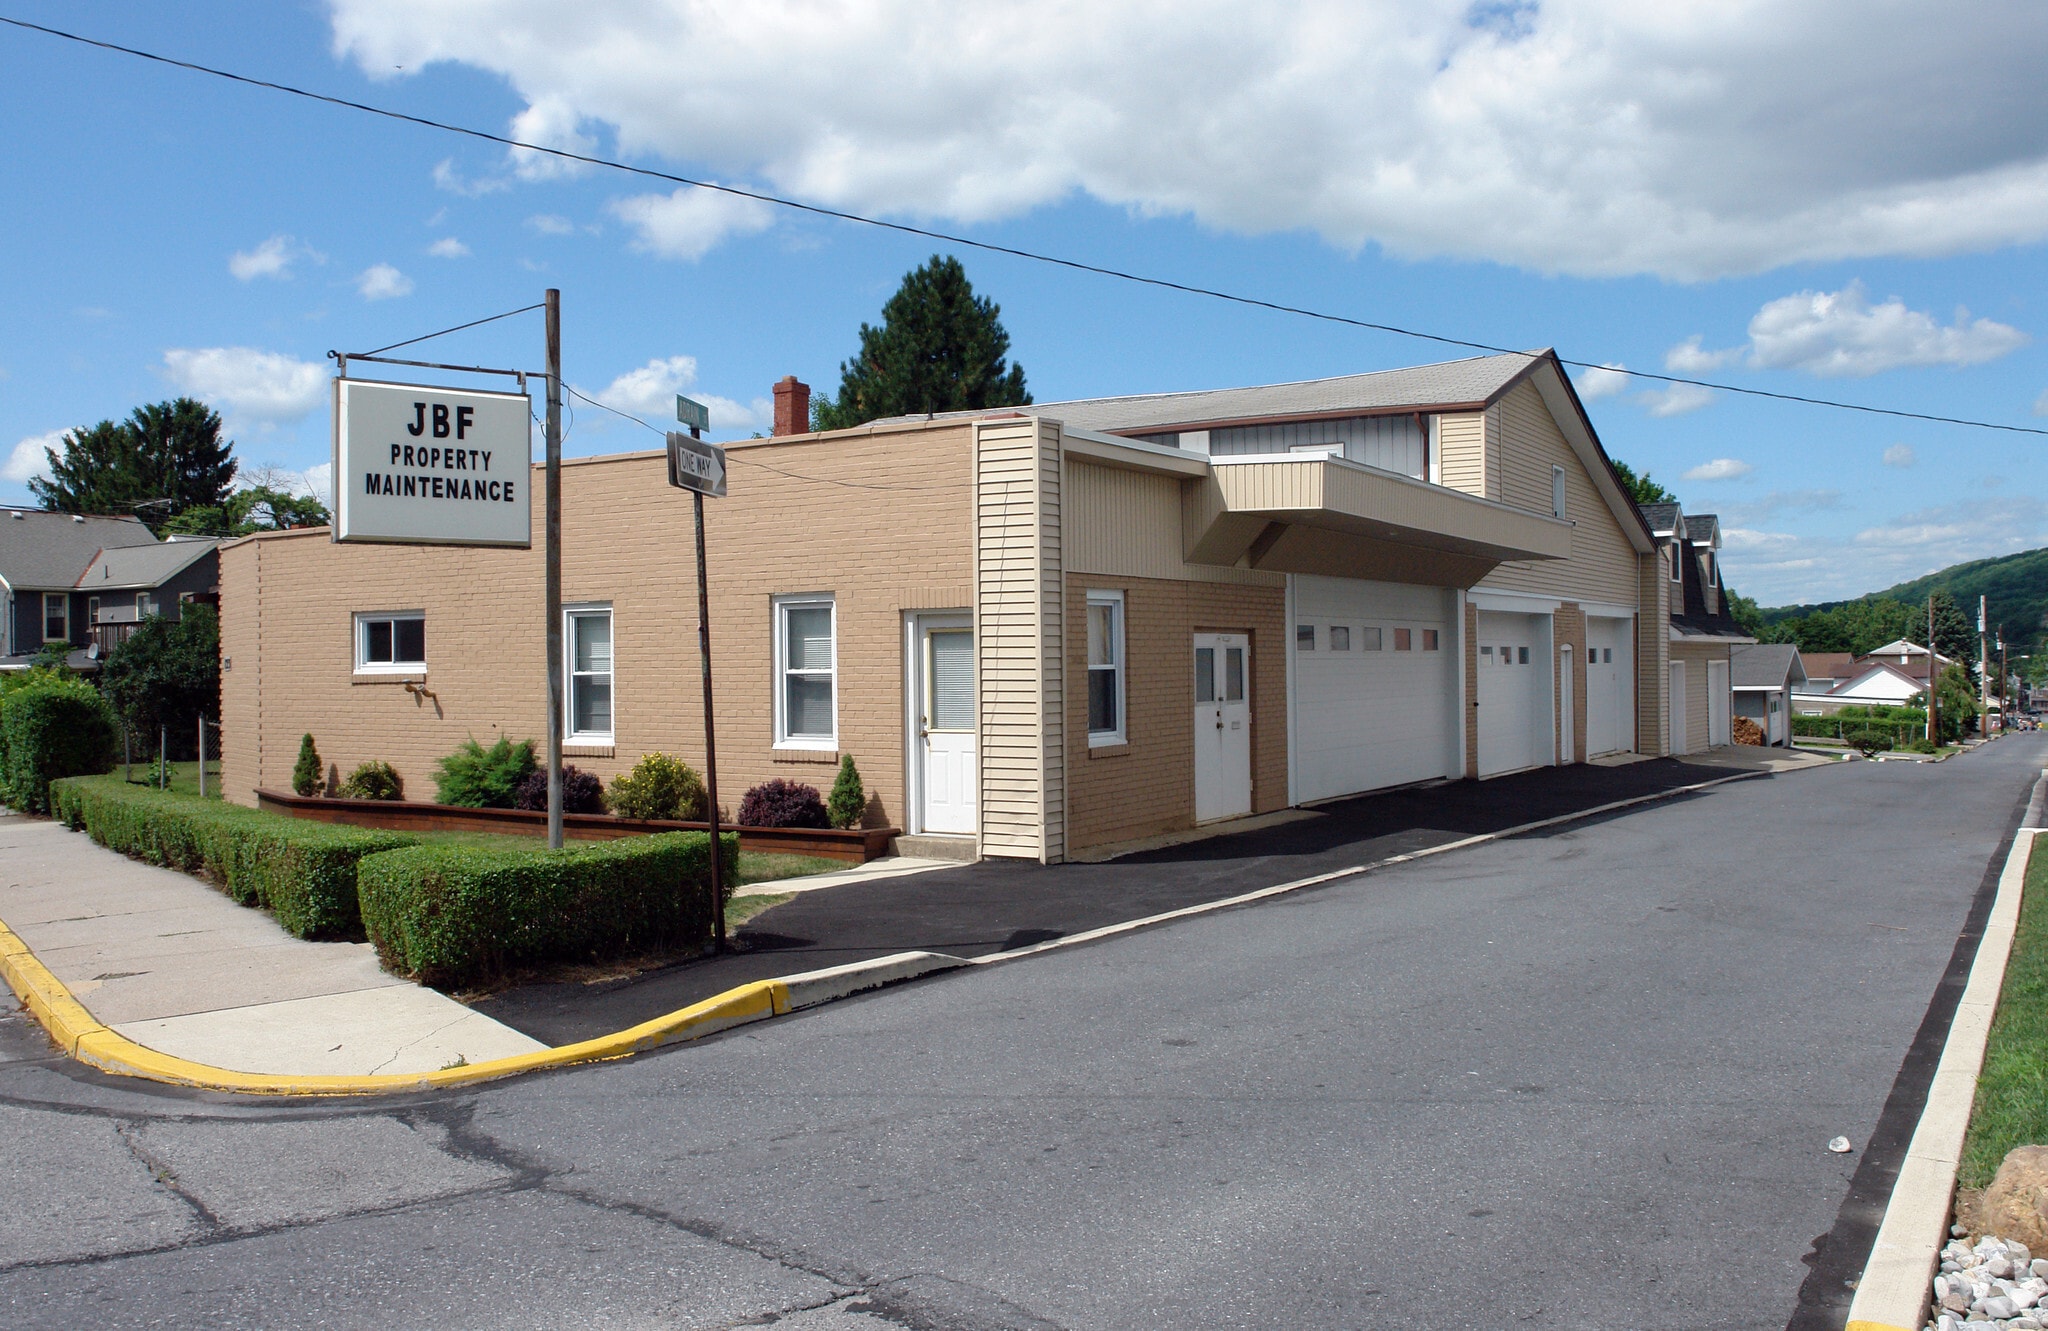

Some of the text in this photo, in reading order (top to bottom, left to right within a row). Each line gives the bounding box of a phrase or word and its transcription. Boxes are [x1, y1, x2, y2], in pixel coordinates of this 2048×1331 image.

[407, 402, 474, 440] JBF
[391, 443, 491, 472] PROPERTY
[681, 450, 711, 478] ONE WAY
[366, 473, 514, 502] MAINTENANCE
